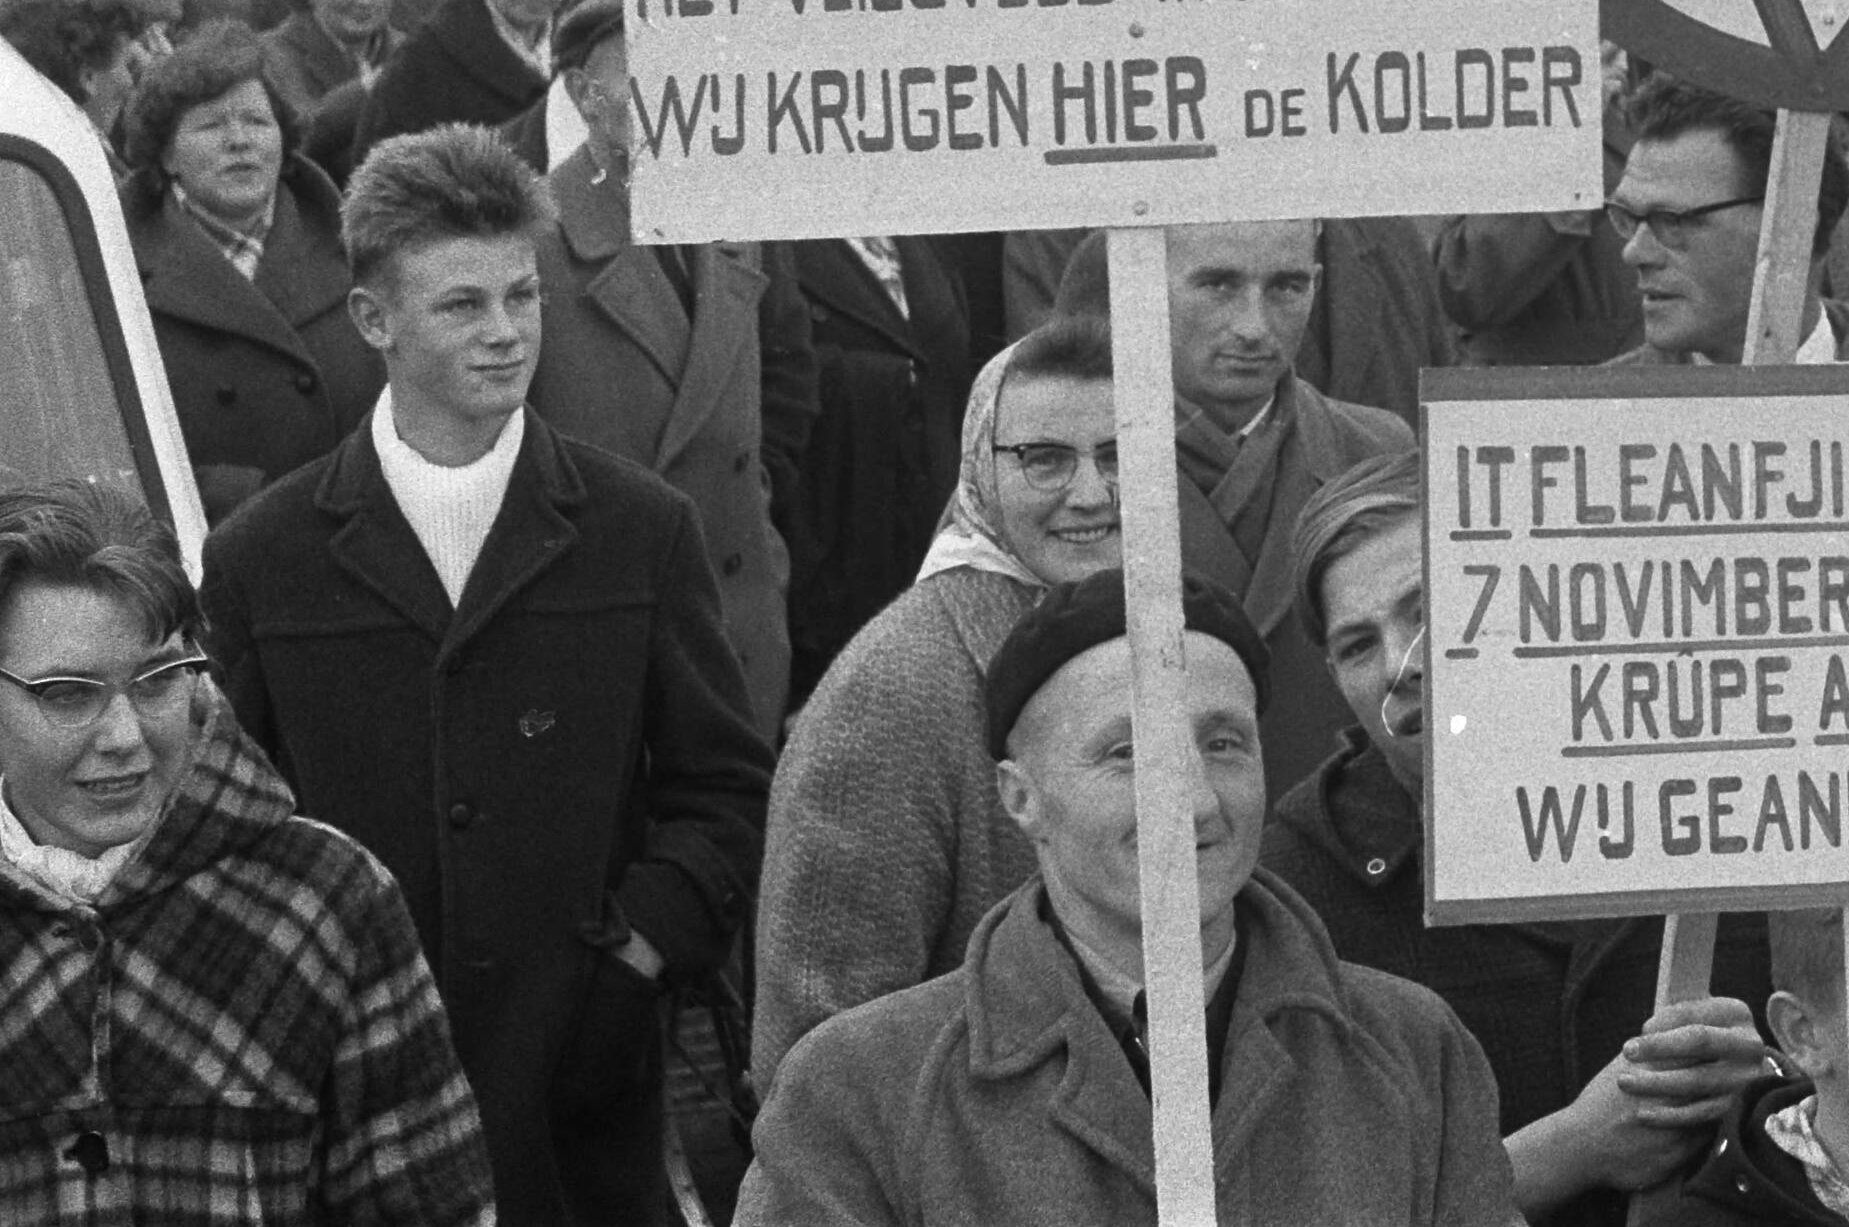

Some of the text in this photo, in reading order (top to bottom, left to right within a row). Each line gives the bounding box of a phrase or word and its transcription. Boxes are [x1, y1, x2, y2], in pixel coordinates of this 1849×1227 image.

[1052, 56, 1208, 143] HIER
[1243, 88, 1306, 137] DE
[1325, 46, 1582, 133] KOLDER
[1456, 444, 1514, 528] IT
[1463, 564, 1500, 644] 7
